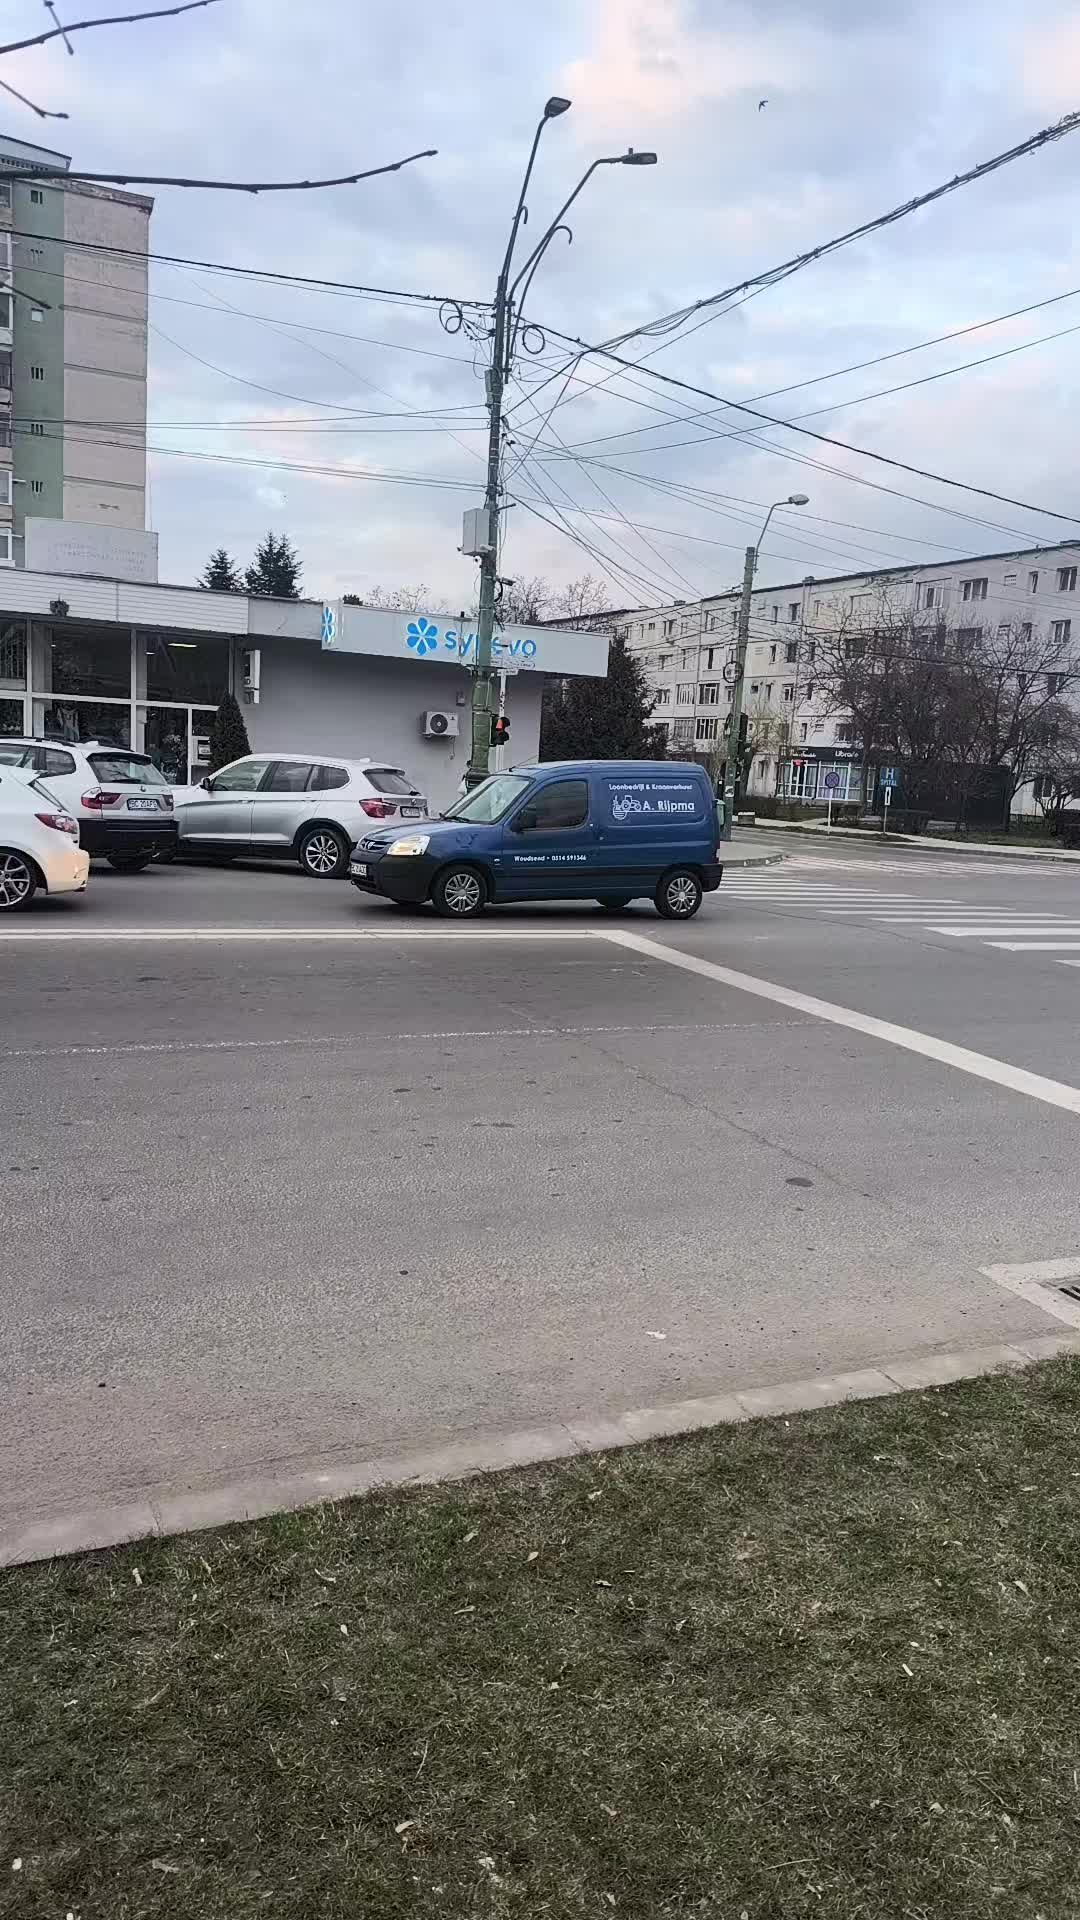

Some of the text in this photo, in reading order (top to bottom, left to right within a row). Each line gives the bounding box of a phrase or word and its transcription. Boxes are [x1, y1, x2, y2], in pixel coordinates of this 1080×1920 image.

[445, 631, 537, 657] syevo
[886, 768, 895, 779] H
[643, 800, 695, 812] A. Rijpma
